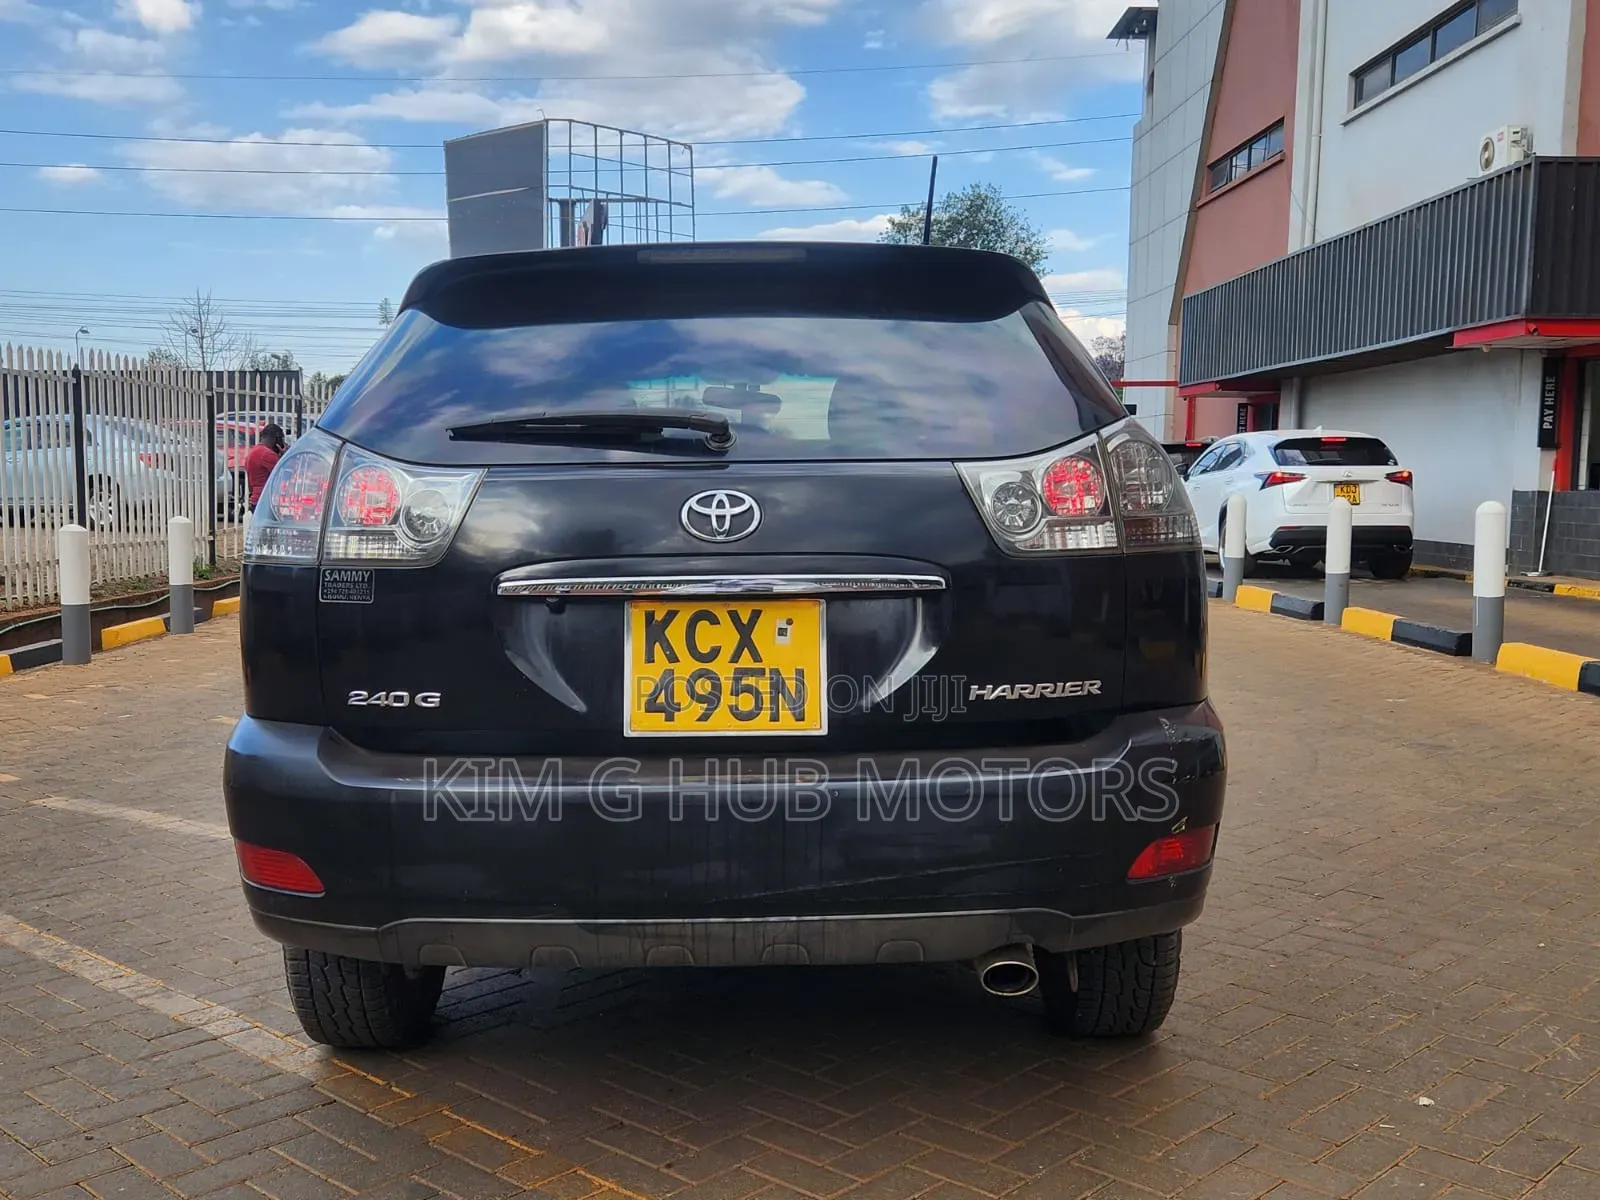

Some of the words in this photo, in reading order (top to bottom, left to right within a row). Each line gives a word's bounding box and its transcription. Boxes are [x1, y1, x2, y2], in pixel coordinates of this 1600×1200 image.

[1544, 376, 1556, 405] HERE
[1543, 408, 1554, 429] PAY
[324, 570, 370, 582] SAMMY
[644, 609, 764, 664] KCX
[348, 690, 410, 707] 240
[414, 691, 442, 708] G
[644, 668, 806, 722] 495N
[968, 679, 1103, 701] HARRIER
